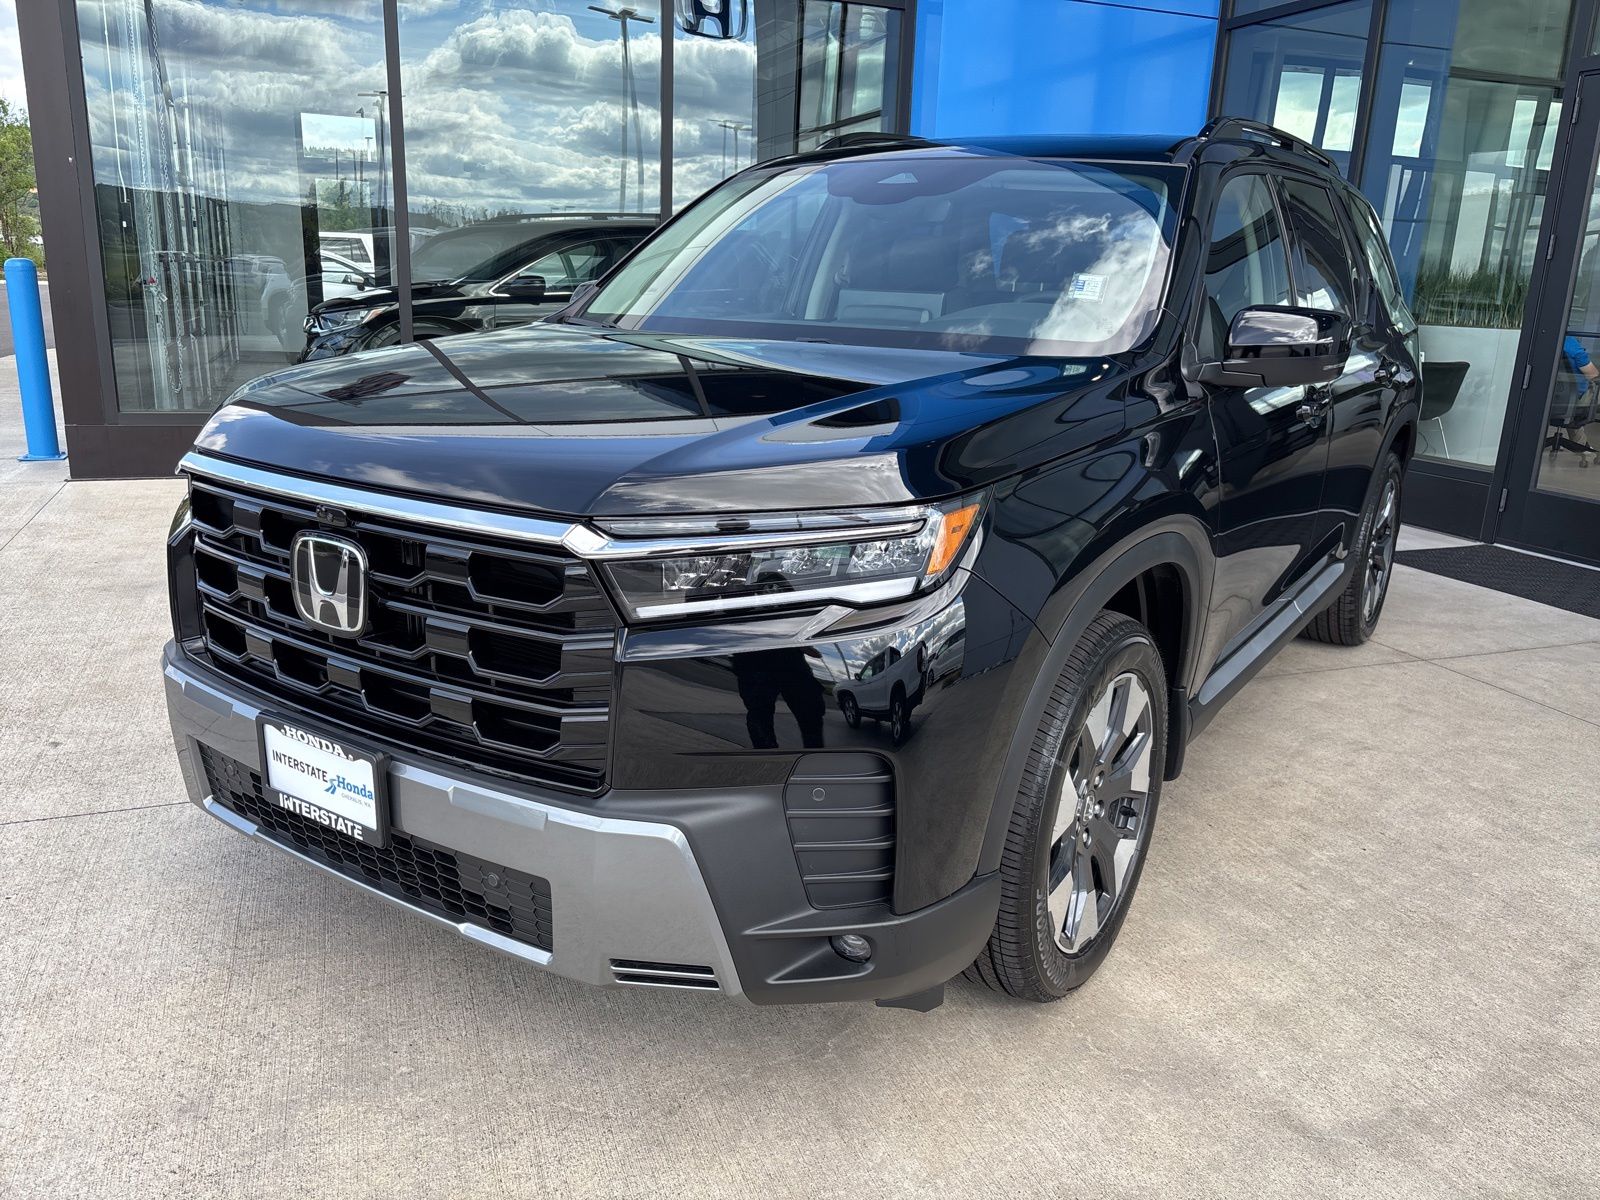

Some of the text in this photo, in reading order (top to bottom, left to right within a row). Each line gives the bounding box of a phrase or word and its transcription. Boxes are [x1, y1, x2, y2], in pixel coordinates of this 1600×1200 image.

[283, 724, 348, 760] HONDA
[272, 749, 374, 800] INTERSTATE Honda
[278, 792, 364, 841] INTERSTATE
